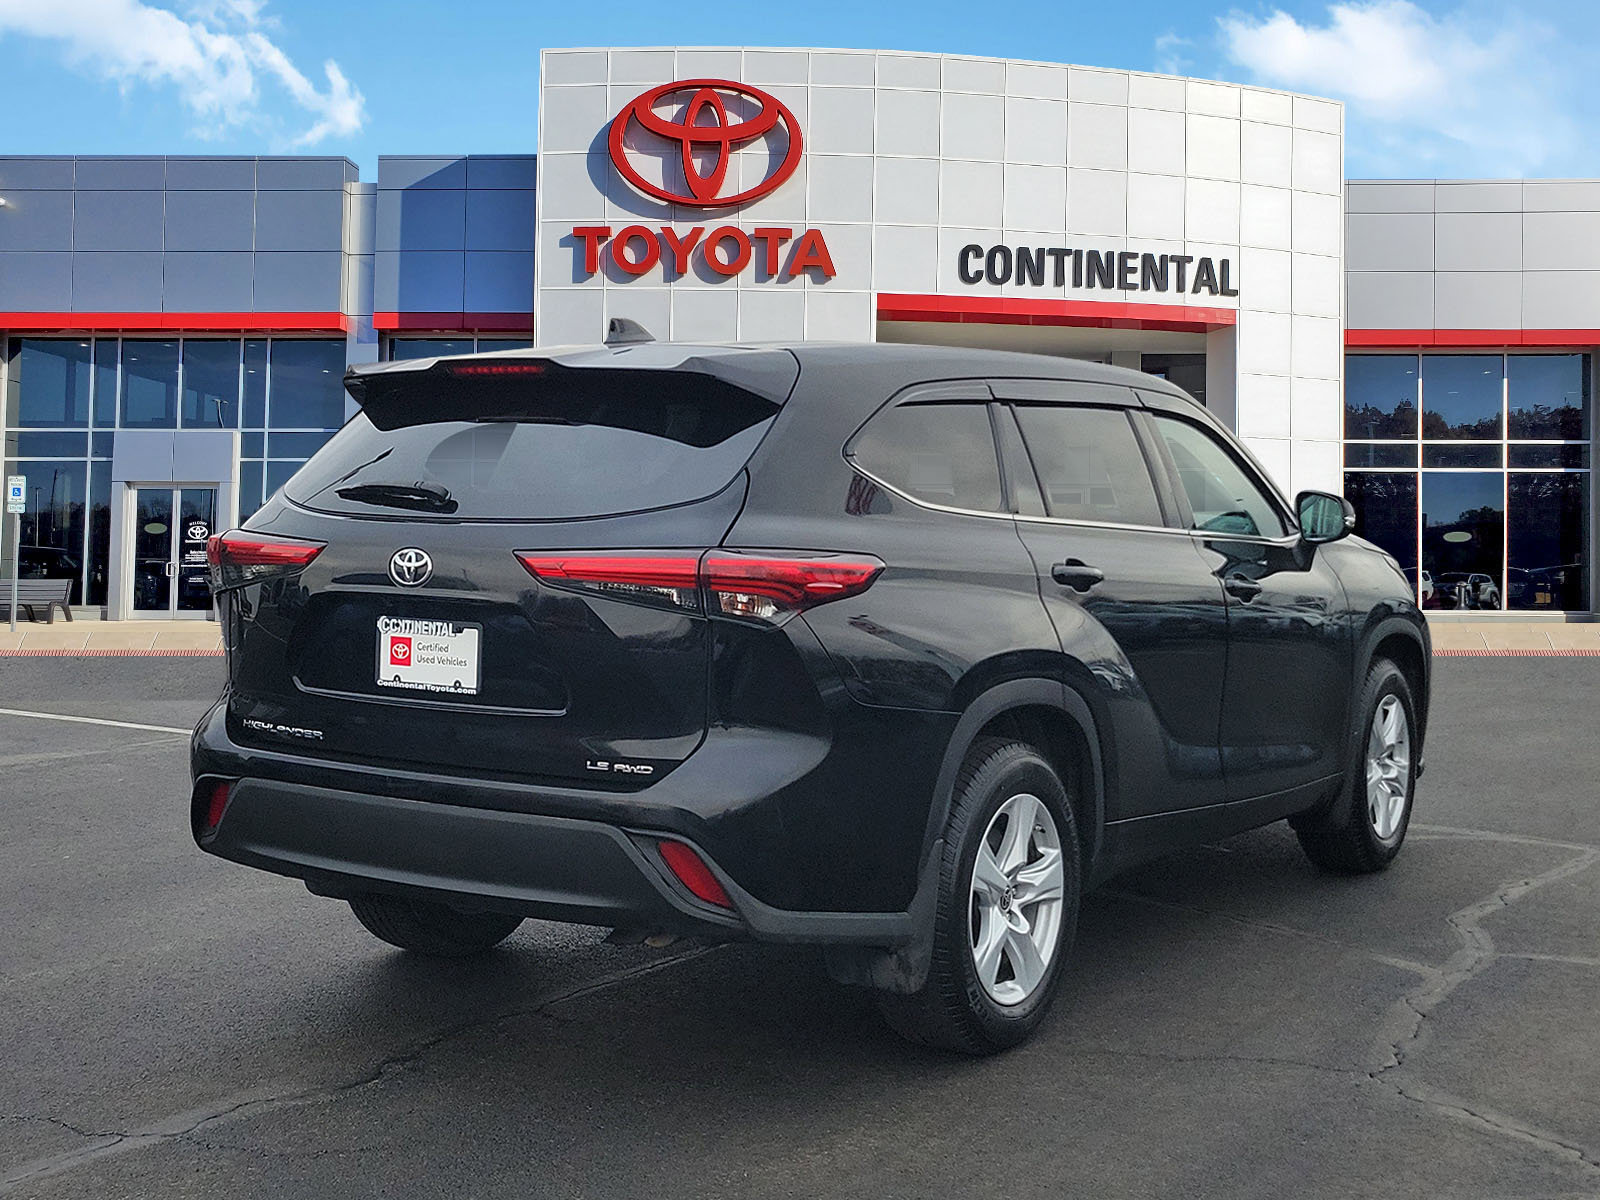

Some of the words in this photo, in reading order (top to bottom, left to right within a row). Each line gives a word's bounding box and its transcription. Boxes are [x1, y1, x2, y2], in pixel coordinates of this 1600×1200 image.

[573, 225, 837, 276] TOYOTA
[958, 244, 1239, 297] CONTINENTAL
[377, 615, 456, 637] CONTINENTAL
[416, 642, 449, 653] Certified
[416, 655, 436, 665] Used
[437, 656, 468, 667] Vehicles
[376, 679, 477, 695] ContinentalToyota.com
[242, 718, 324, 740] HIGHLANDER
[586, 760, 610, 771] LE
[613, 763, 654, 775] AWD
